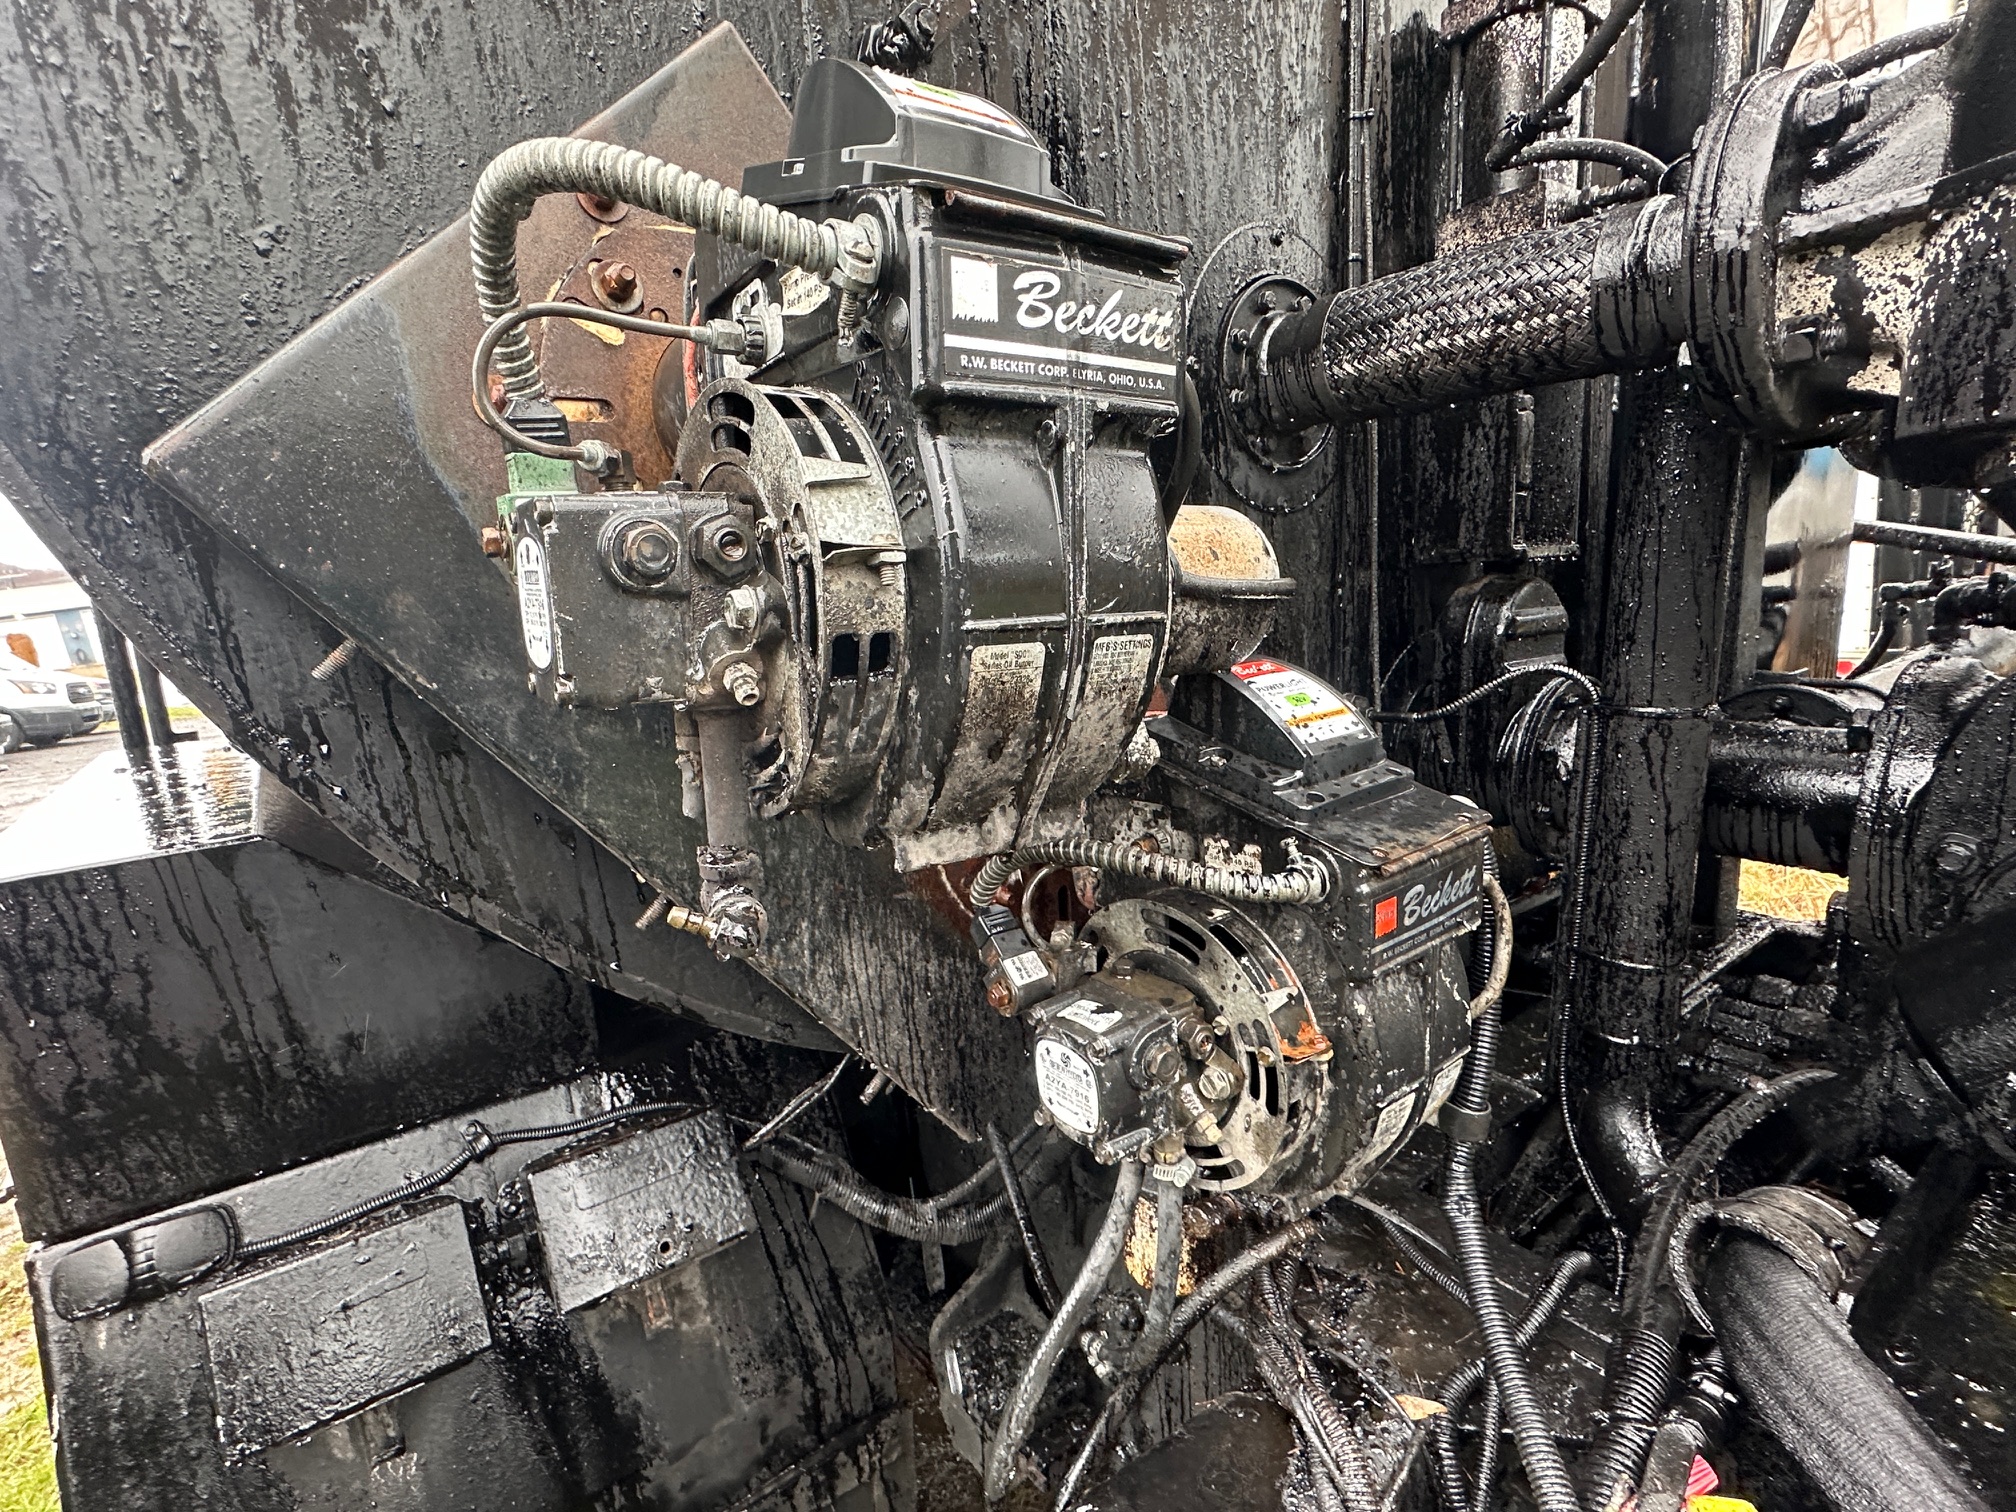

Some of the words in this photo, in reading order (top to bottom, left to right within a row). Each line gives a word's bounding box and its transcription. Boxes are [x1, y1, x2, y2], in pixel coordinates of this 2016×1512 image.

[1013, 270, 1173, 349] Beckett
[960, 354, 988, 371] R.W.
[990, 360, 1035, 375] BECKETT
[1038, 364, 1070, 378] CORP.
[1072, 368, 1107, 384] ELYRIA,
[1109, 373, 1137, 388] OHIO,
[1138, 376, 1166, 391] U.S.A.
[1403, 864, 1477, 926] Beckett
